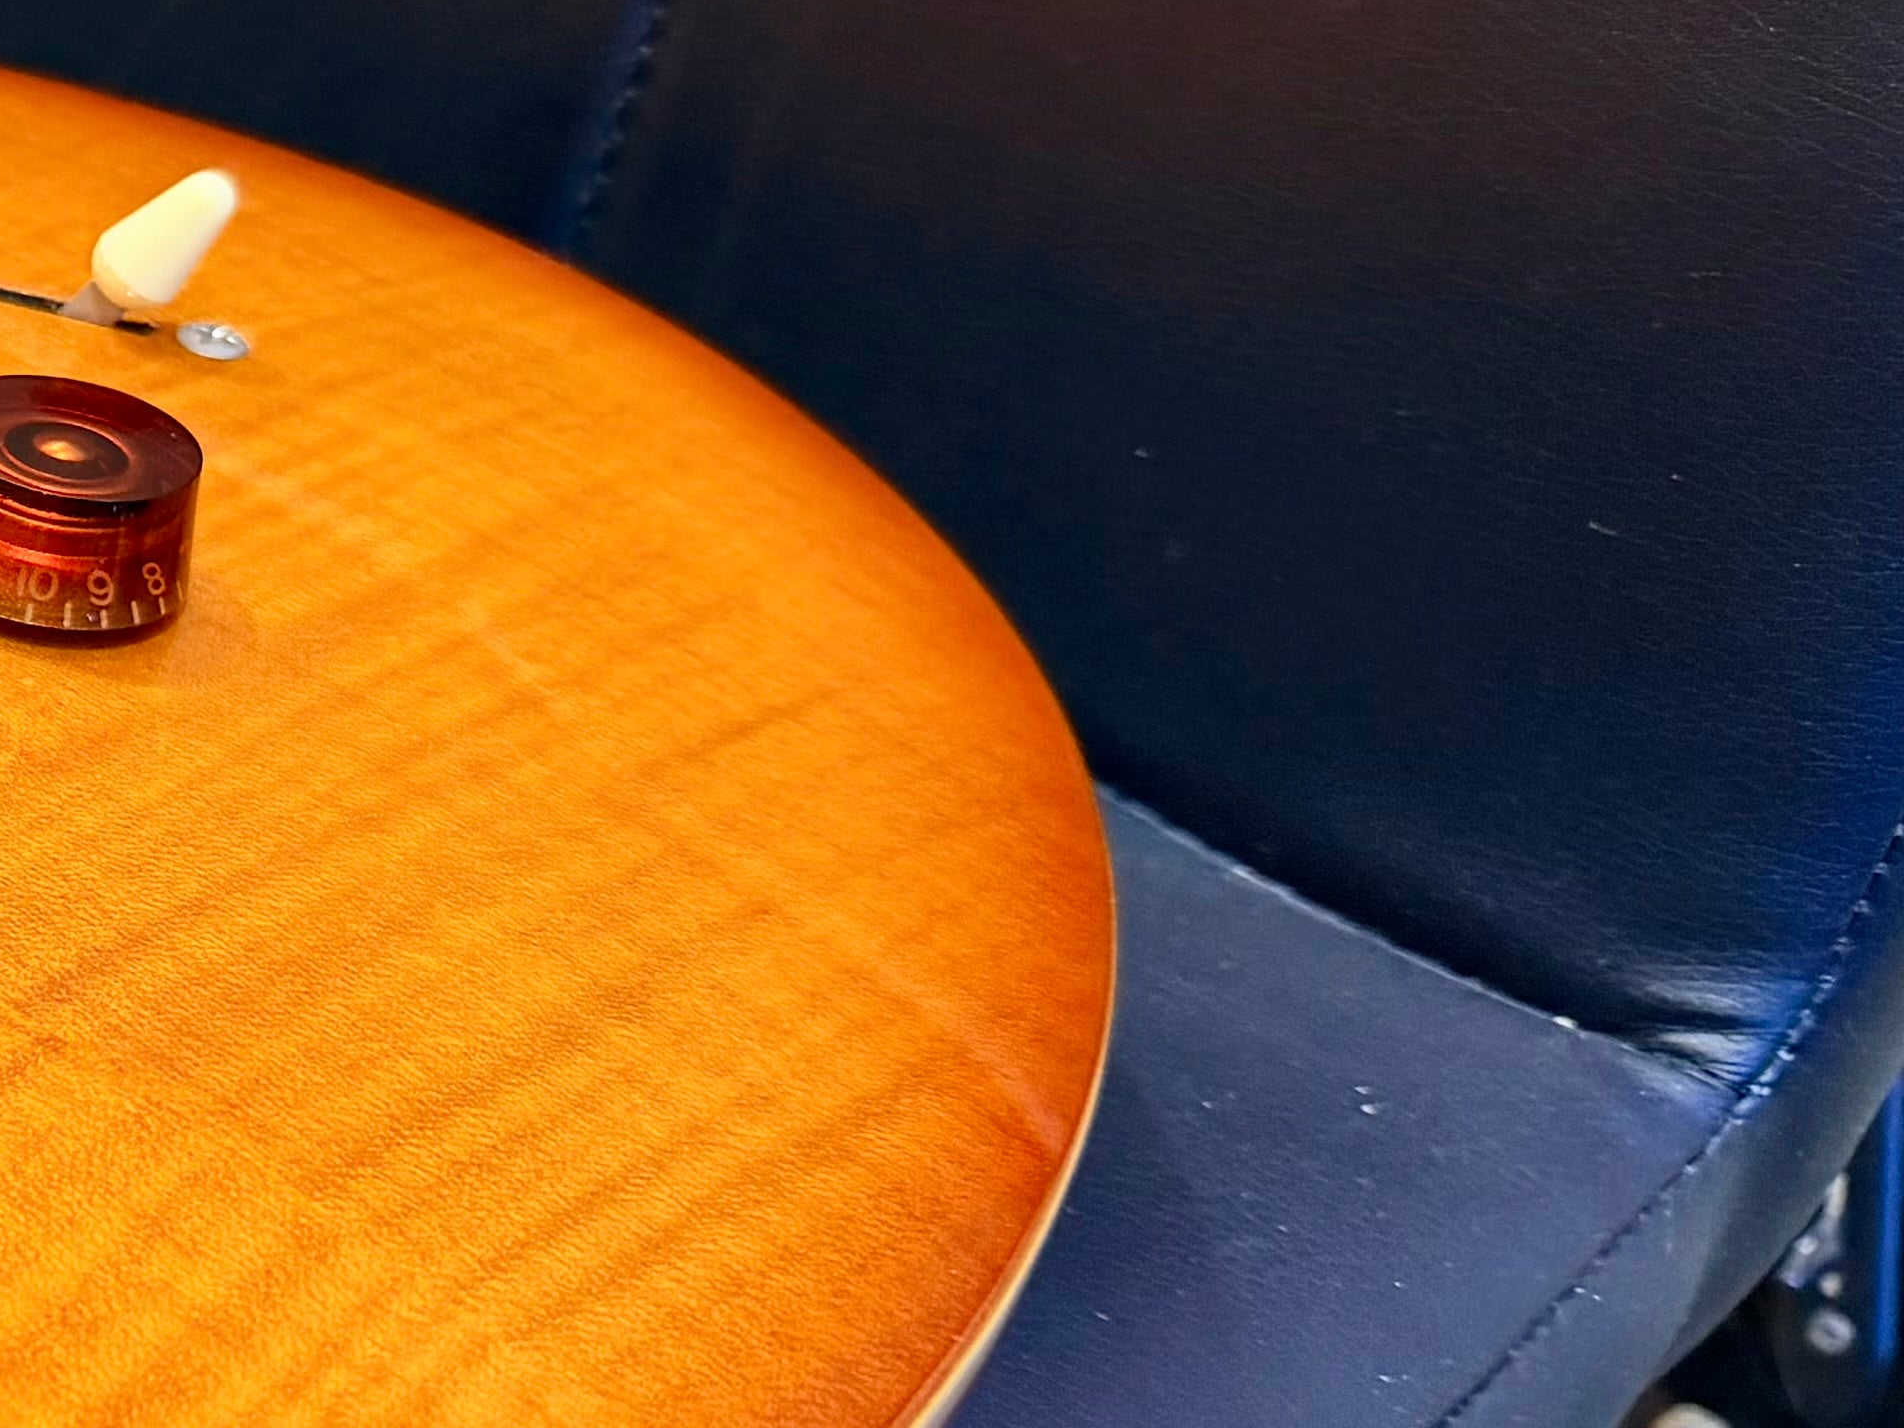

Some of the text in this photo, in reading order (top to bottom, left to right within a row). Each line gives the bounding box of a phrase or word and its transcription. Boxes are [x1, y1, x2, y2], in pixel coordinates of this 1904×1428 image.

[17, 566, 59, 601] 10
[87, 570, 114, 606] 9
[142, 562, 166, 596] 8
